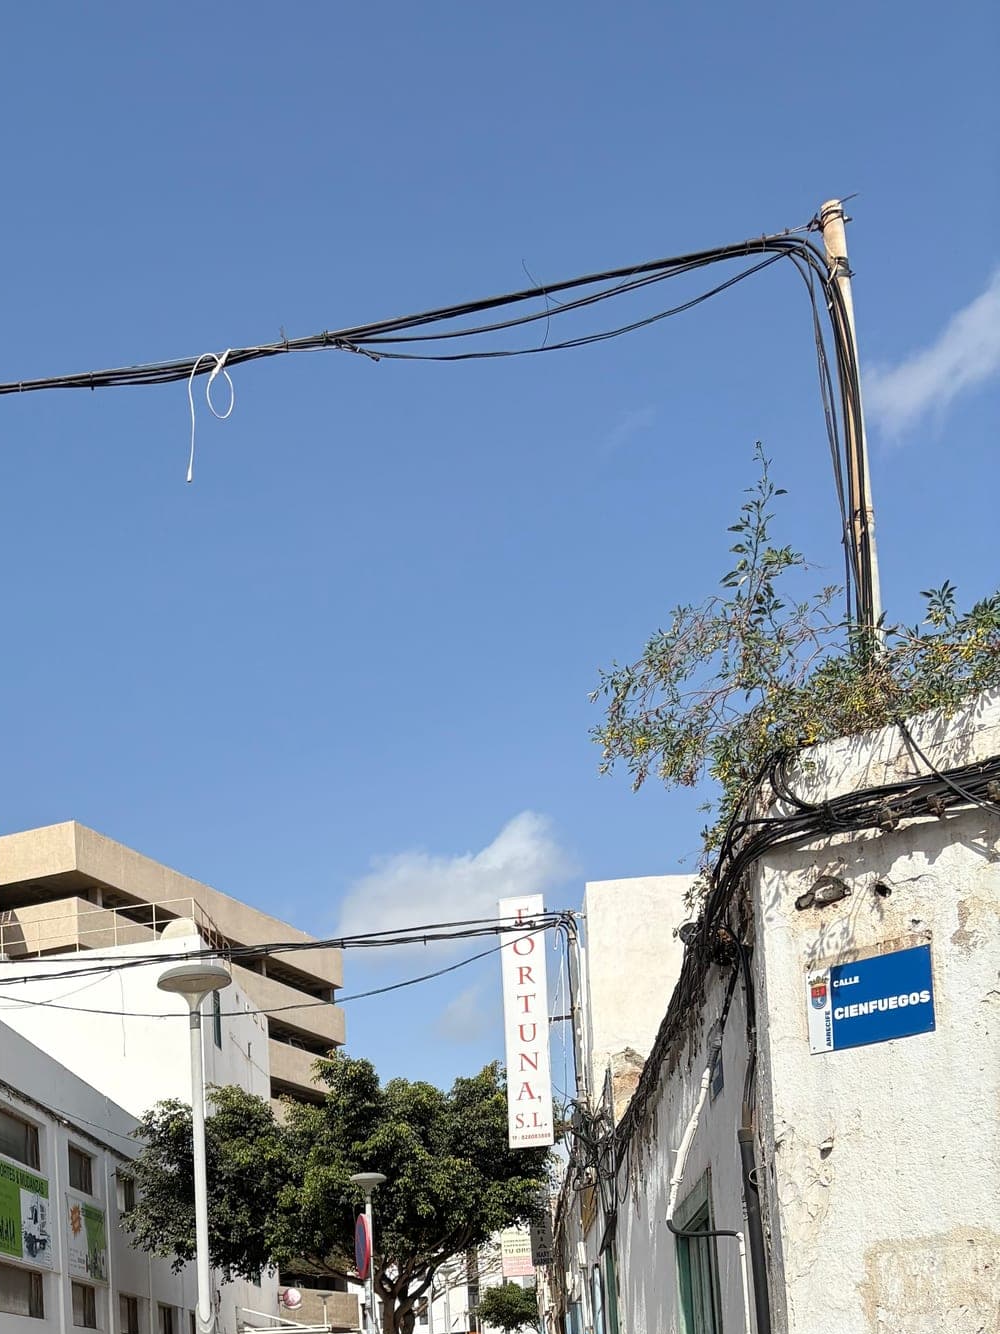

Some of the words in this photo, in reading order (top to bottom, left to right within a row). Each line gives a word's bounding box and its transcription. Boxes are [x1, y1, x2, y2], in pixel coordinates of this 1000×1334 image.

[833, 975, 860, 988] CALLE
[833, 990, 931, 1020] CIENFUEGOS
[515, 1112, 548, 1129] S.L.
